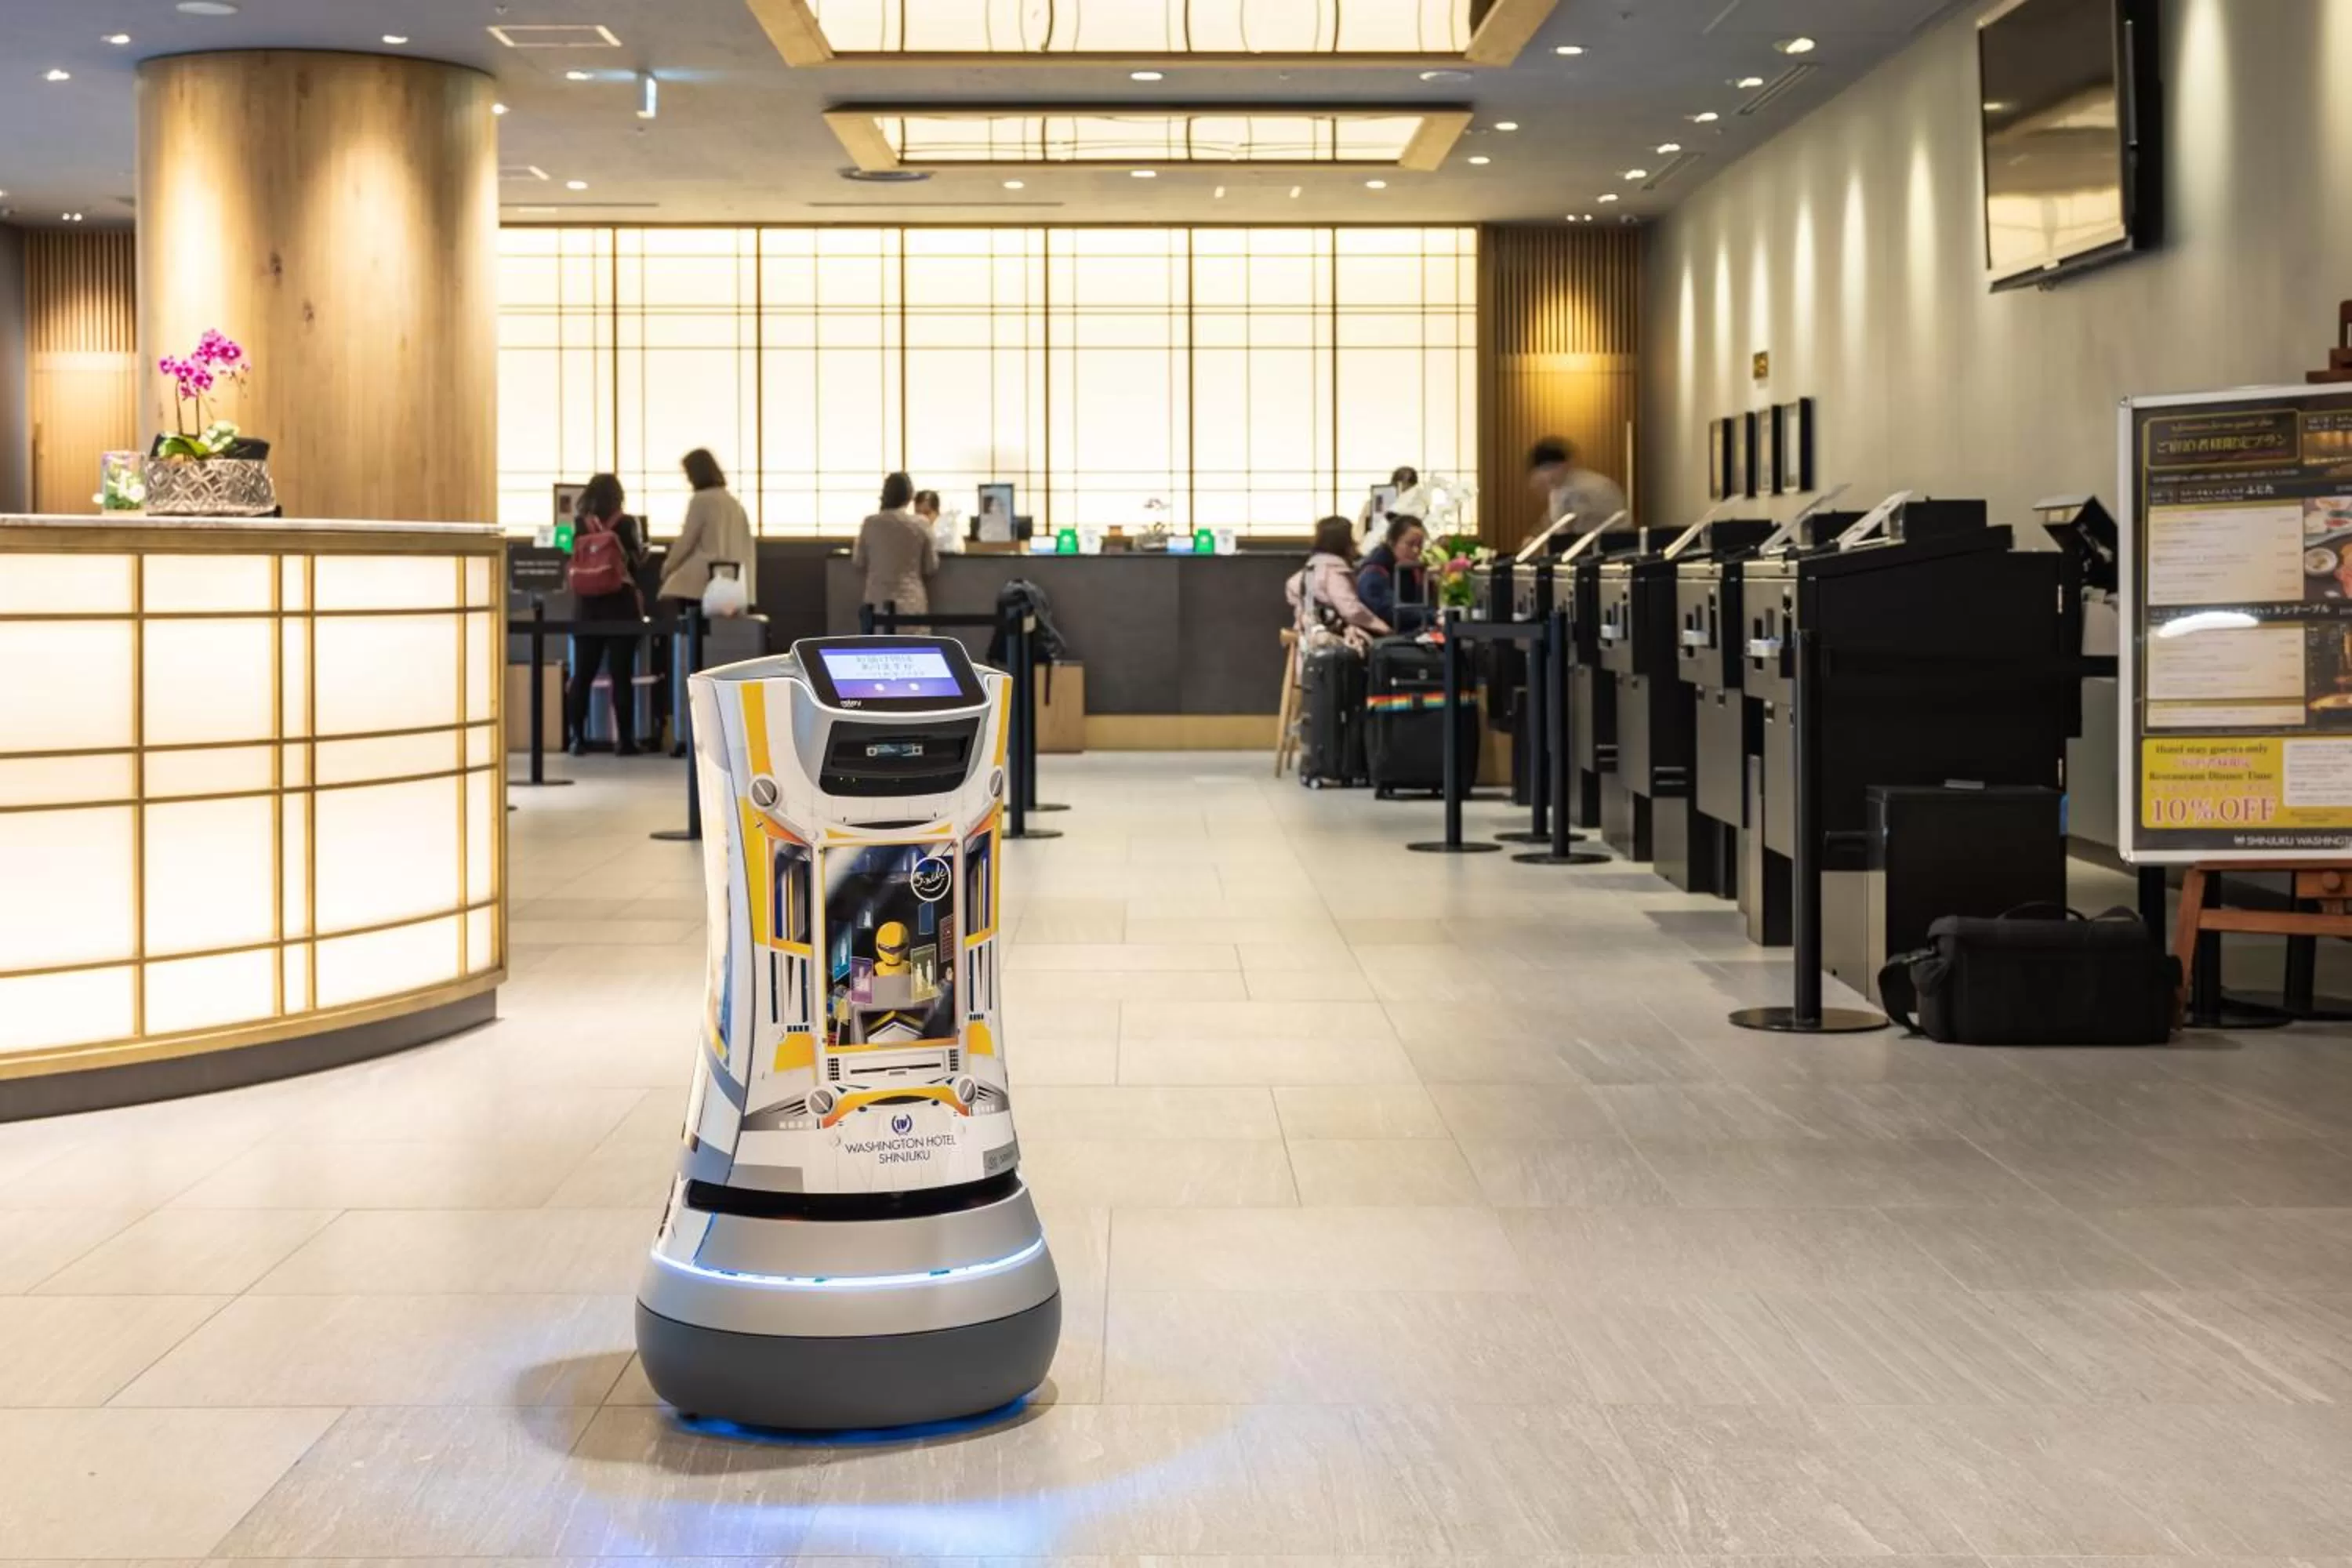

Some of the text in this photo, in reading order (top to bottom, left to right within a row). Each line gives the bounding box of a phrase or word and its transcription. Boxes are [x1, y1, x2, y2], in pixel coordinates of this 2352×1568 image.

[2153, 797, 2276, 822] 10%OFF
[845, 1134, 956, 1154] WASHINGTON HOTEL
[879, 1150, 931, 1163] SHINJUKU
